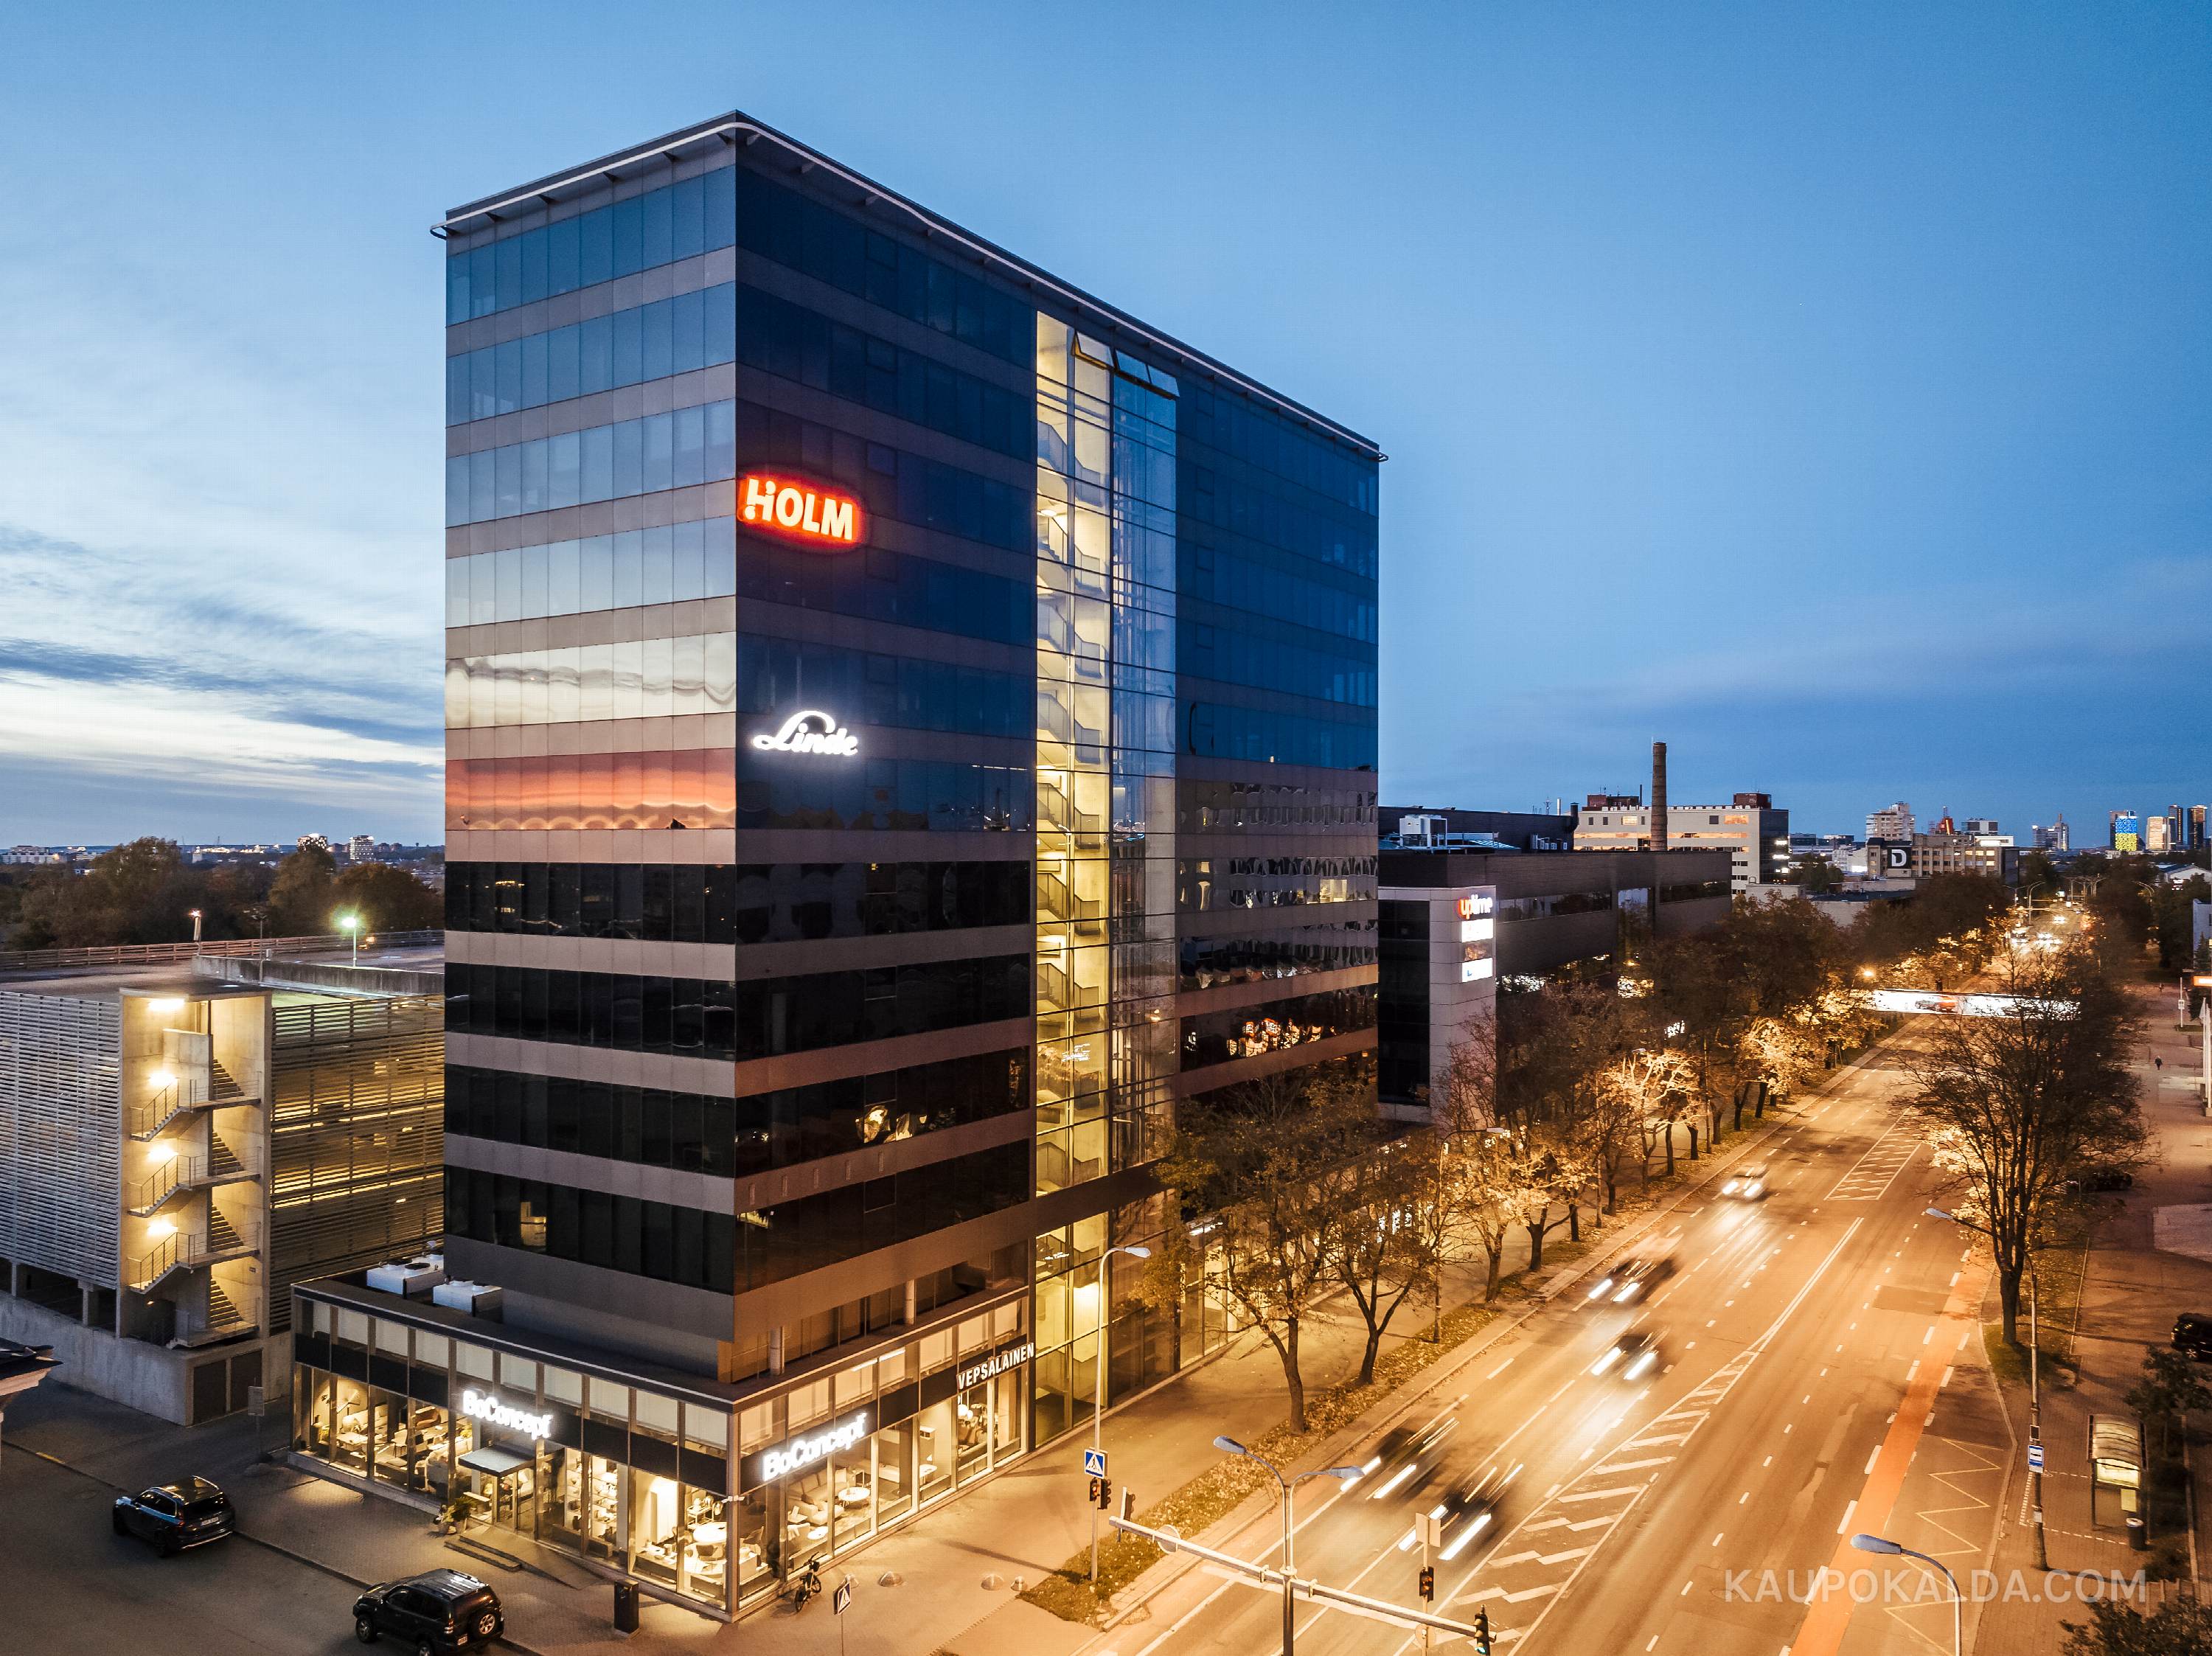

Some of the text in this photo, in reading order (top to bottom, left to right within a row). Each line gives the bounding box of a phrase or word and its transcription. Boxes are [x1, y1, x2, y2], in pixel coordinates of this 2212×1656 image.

[744, 478, 853, 540] HOLM
[753, 710, 858, 756] Linde
[1460, 894, 1494, 920] uptime
[462, 1389, 554, 1441] BoConcept
[762, 1412, 868, 1482] BoConcept
